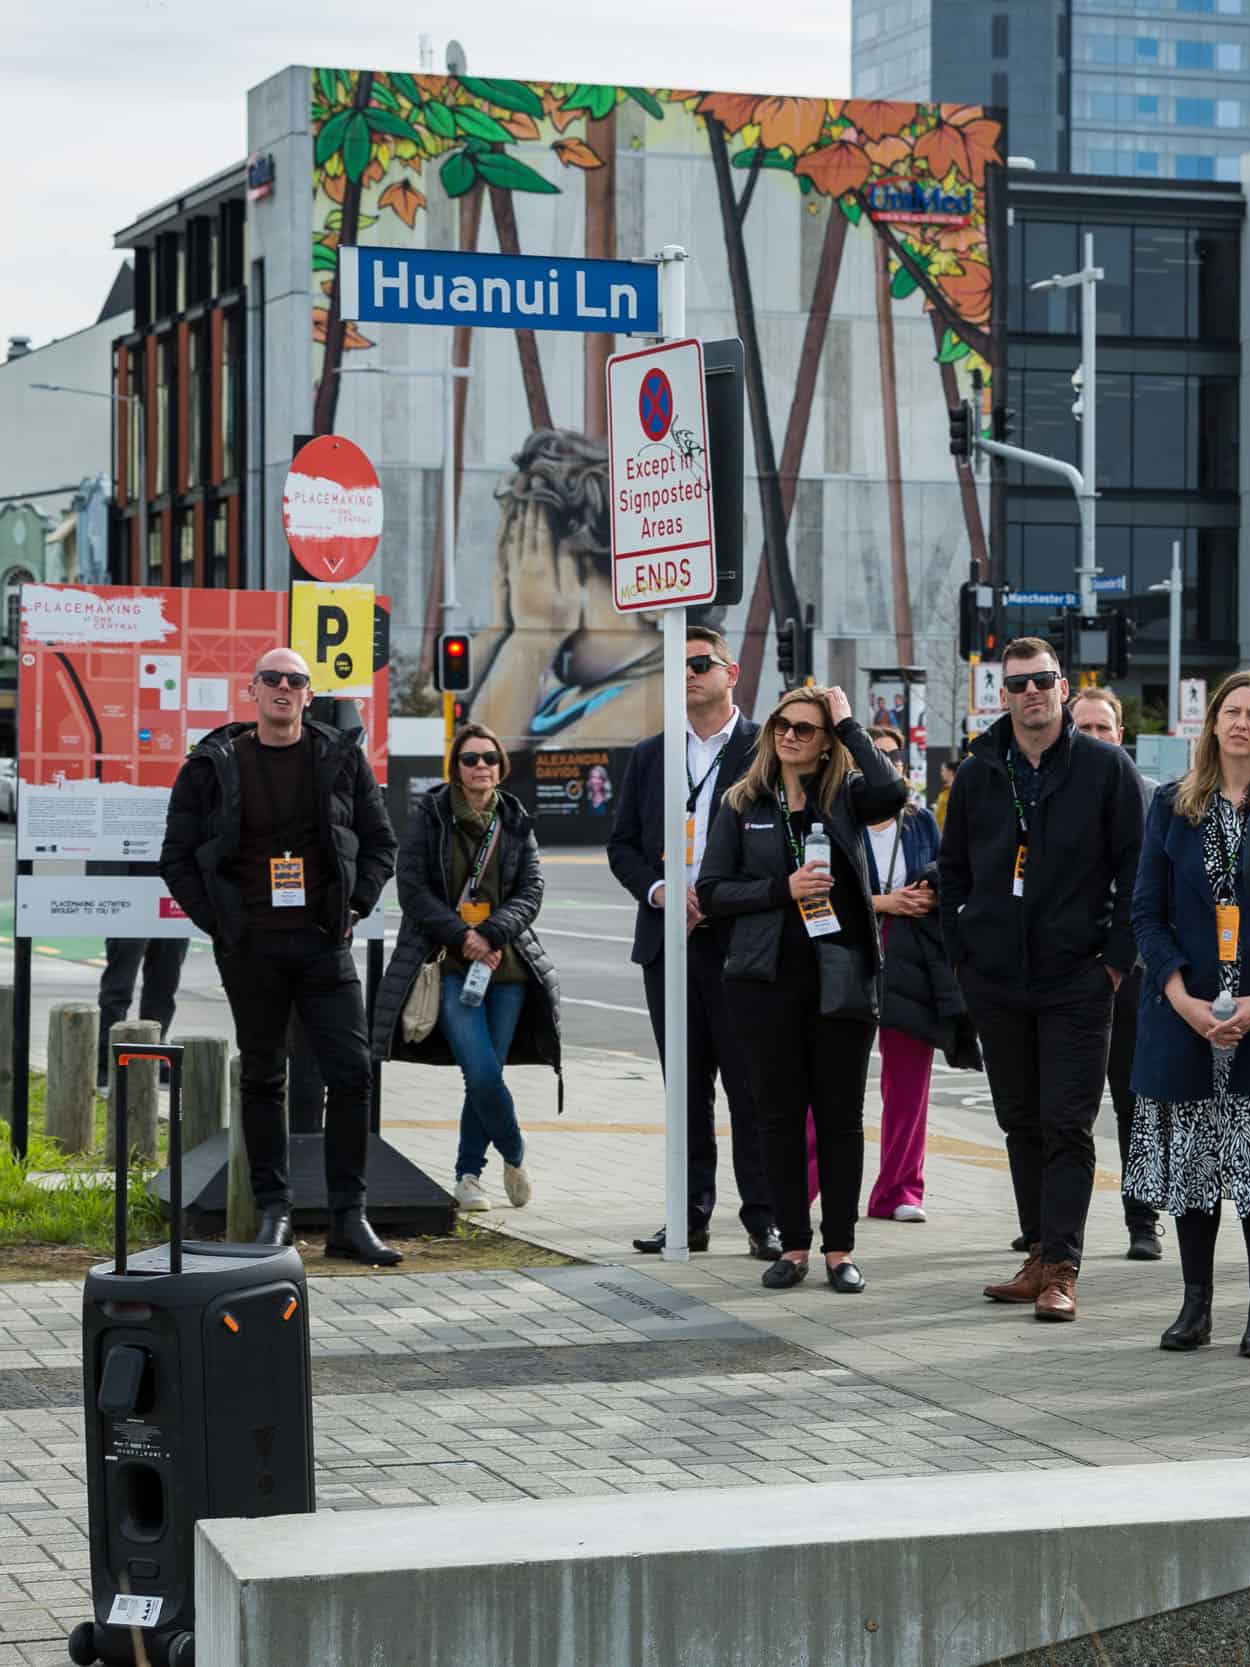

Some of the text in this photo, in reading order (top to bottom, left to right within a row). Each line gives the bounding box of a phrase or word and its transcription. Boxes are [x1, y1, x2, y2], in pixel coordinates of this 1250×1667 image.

[868, 182, 972, 211] UniMed
[373, 259, 638, 320] Huanui Ln
[626, 447, 694, 481] Except in
[294, 491, 374, 507] PLACEMAKING
[619, 477, 703, 514] Signposted
[641, 516, 684, 539] Areas
[635, 558, 692, 593] ENDS
[33, 601, 142, 615] PLACEMAKING
[317, 604, 349, 664] P
